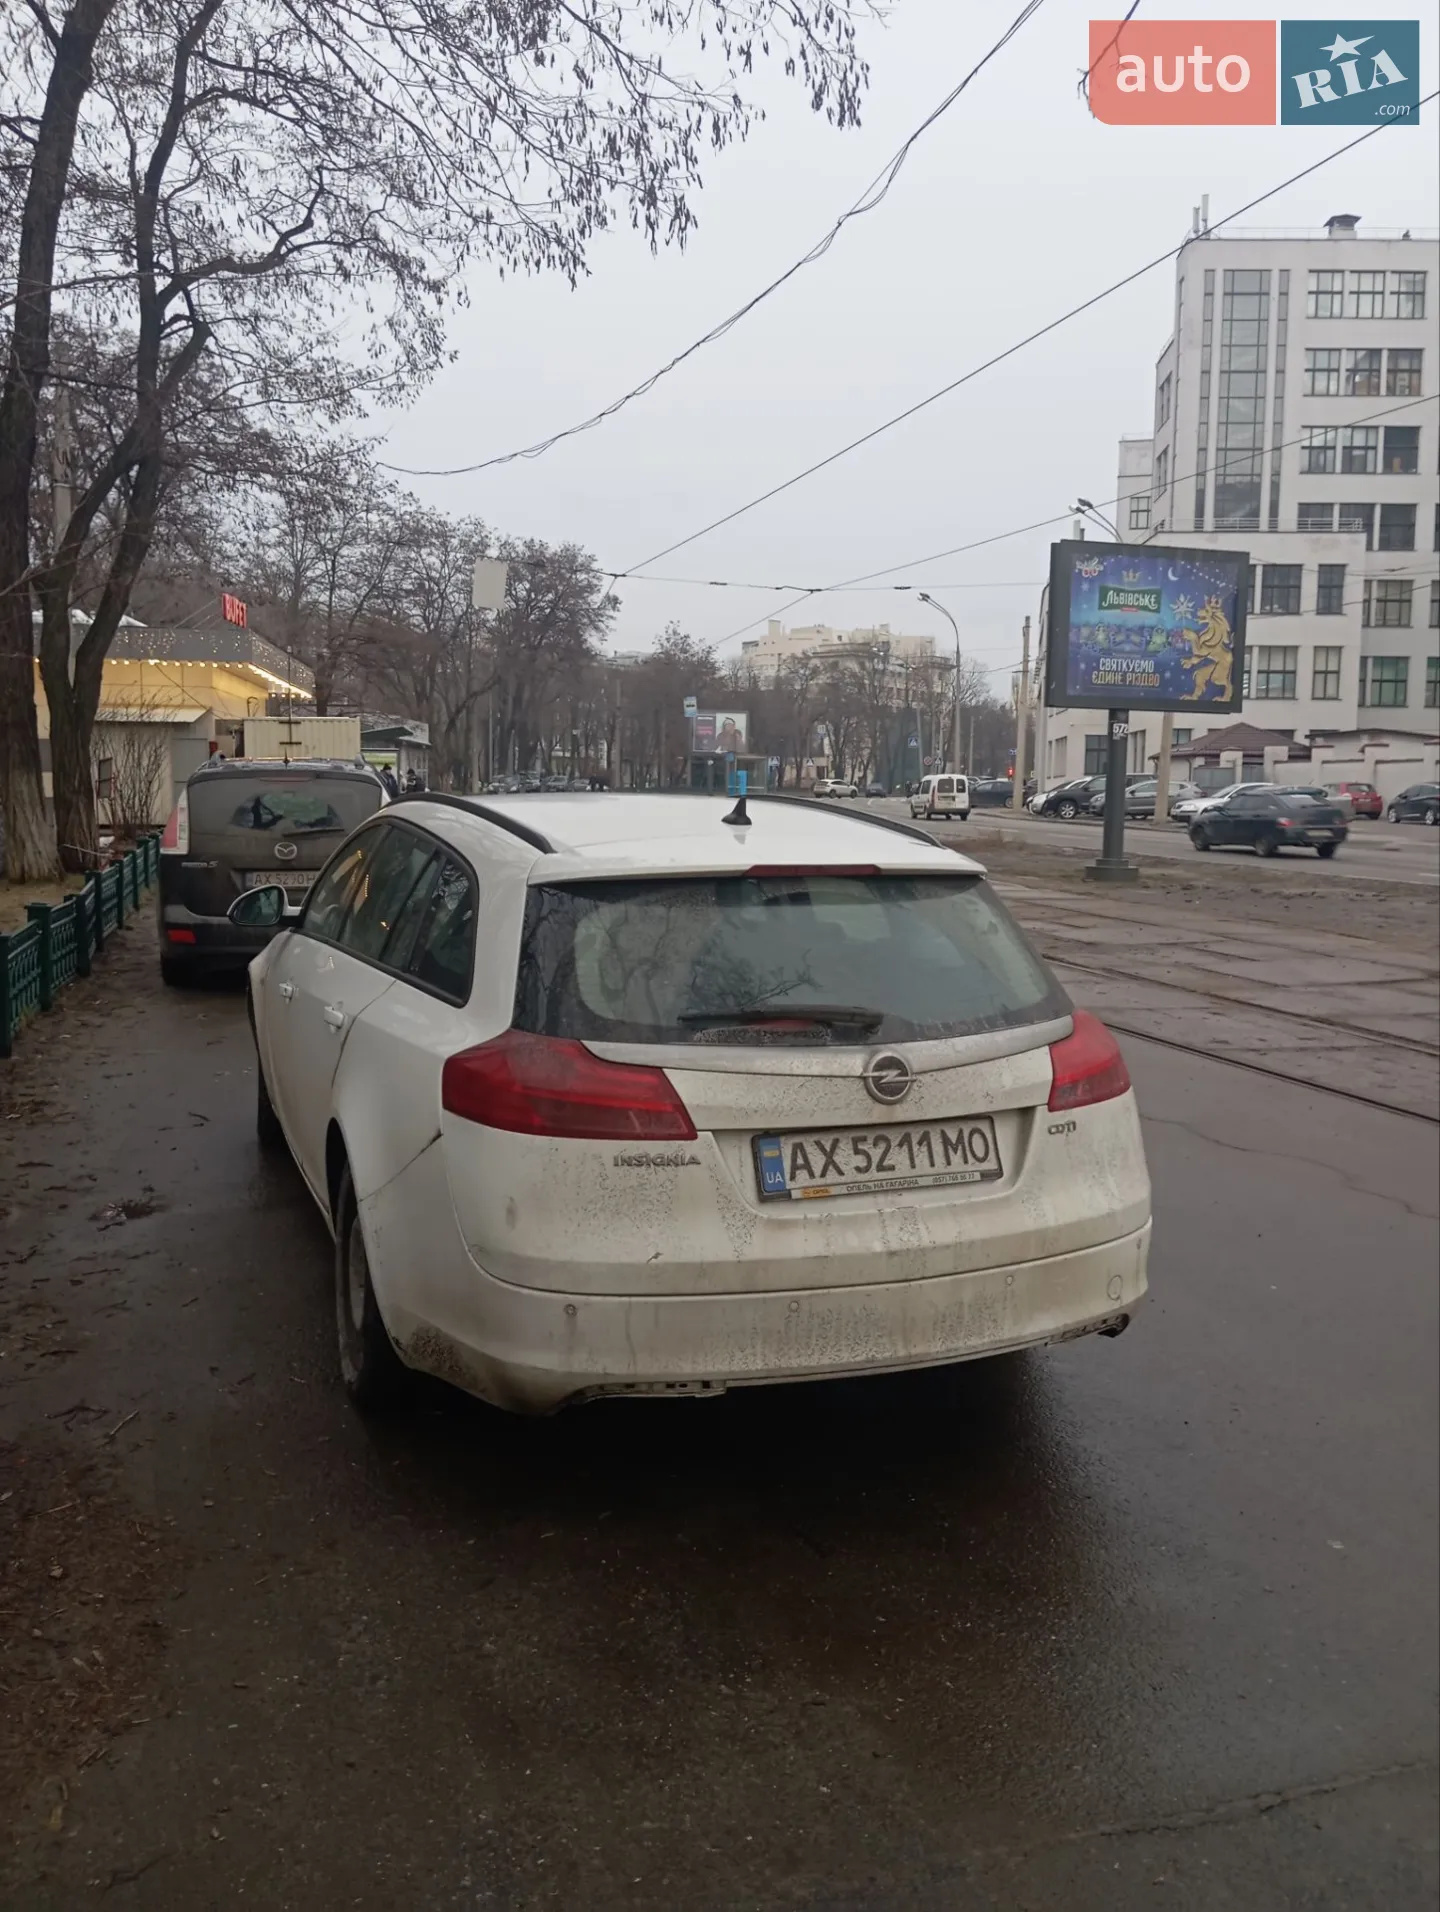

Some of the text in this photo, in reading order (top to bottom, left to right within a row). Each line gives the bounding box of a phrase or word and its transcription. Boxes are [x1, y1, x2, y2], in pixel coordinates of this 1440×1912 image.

[1099, 657, 1155, 673] СВЯТКУЄМО
[1091, 671, 1161, 687] ЄДИНЕ РІЗДВО
[613, 1153, 702, 1167] INSIGNIA
[789, 1126, 990, 1182] AX 5211 MO
[765, 1171, 785, 1185] UA
[846, 1178, 920, 1193] ОПЕЛЬ НА ГАГАРІНА
